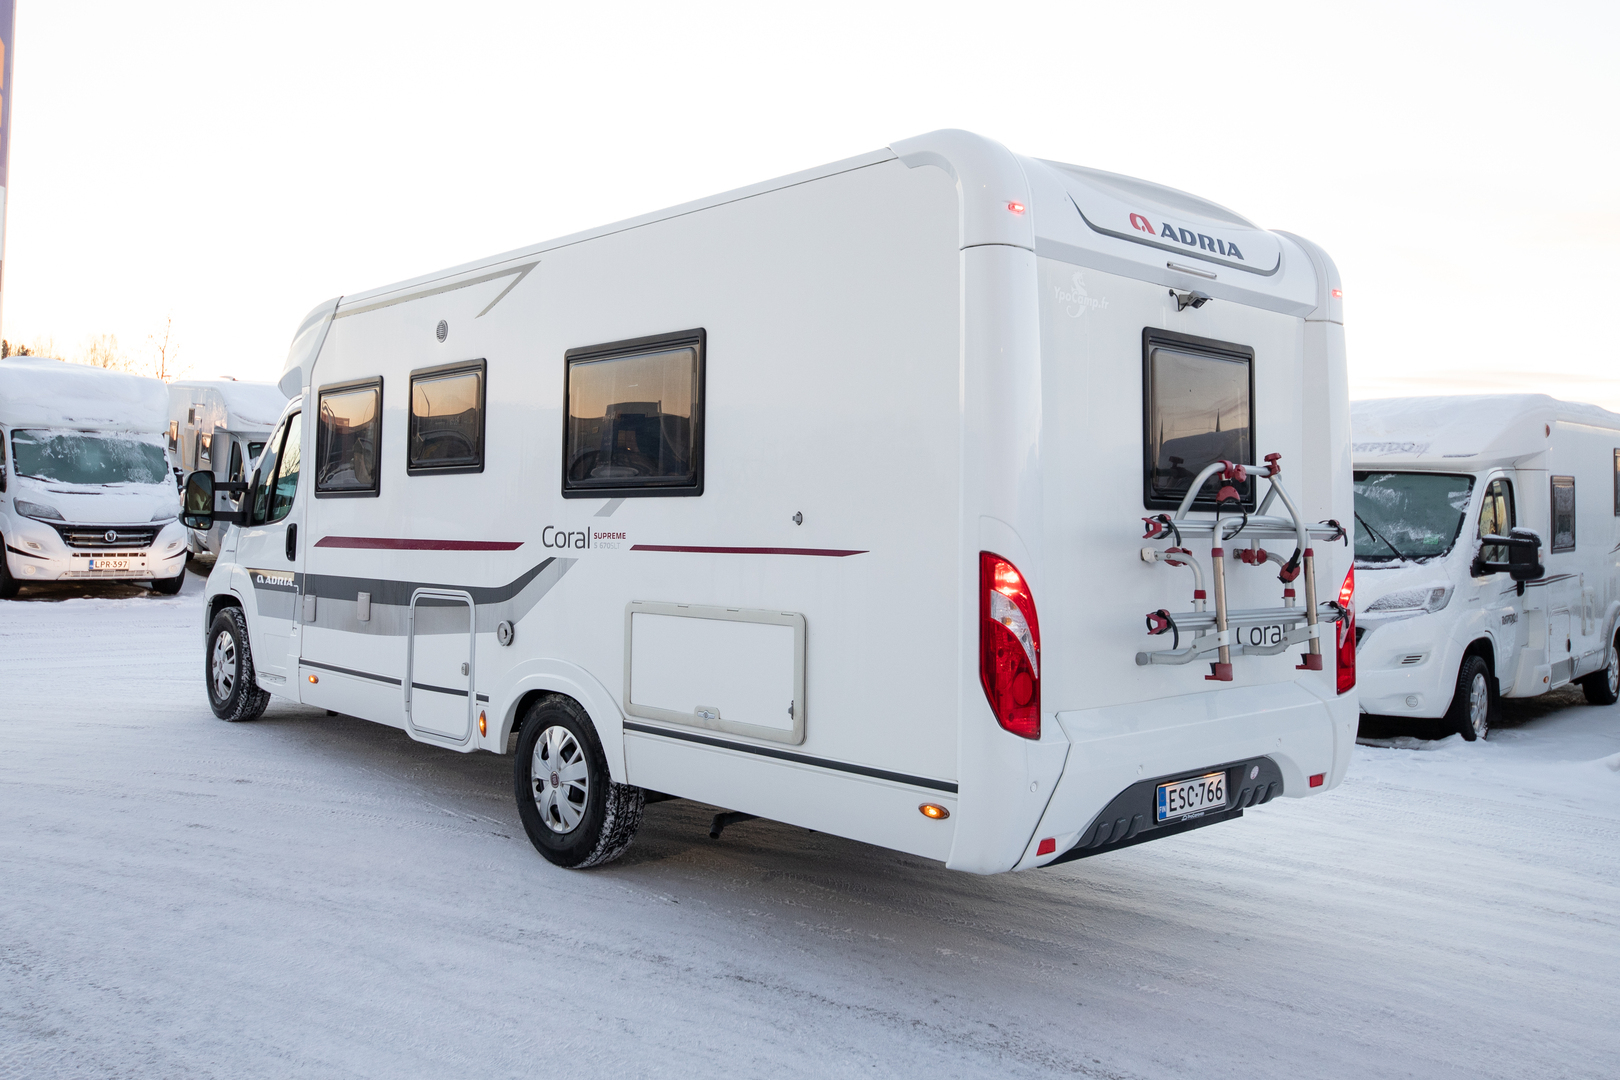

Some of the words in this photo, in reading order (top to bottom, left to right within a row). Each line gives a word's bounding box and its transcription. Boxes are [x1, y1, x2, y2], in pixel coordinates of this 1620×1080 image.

[1160, 222, 1244, 260] ADRIA
[1053, 286, 1109, 311] YpoCamp.fr
[542, 525, 590, 549] Coral
[593, 532, 626, 540] SUPREME
[94, 560, 128, 568] LPR-397
[265, 576, 293, 587] ADRIA
[1168, 779, 1223, 812] ESC-766
